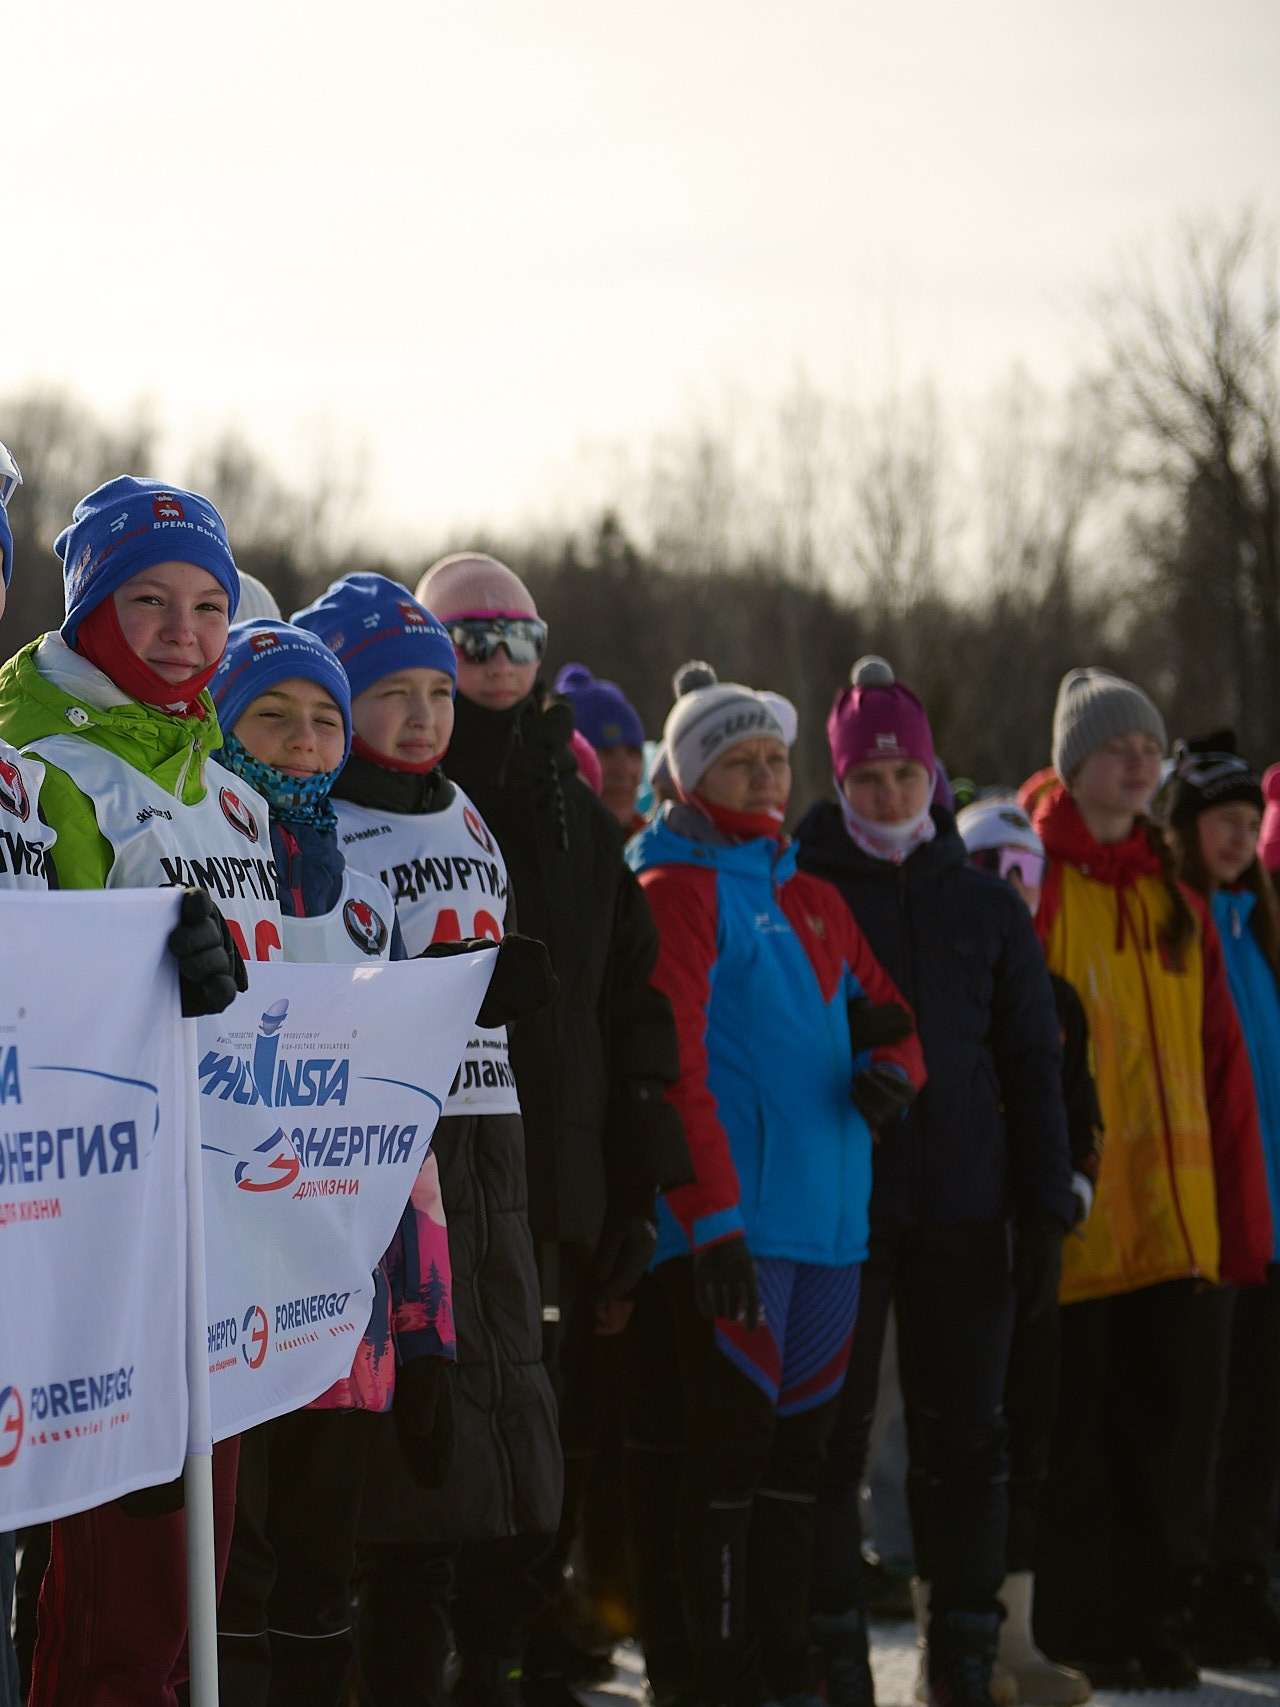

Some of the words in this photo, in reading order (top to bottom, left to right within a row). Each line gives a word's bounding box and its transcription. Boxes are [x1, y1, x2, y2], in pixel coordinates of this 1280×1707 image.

[153, 520, 194, 530] ВРЕМЯ
[196, 525, 224, 546] БЫТЬ
[253, 644, 289, 662] ВРЕМЯ
[292, 643, 322, 657] БЫТЬ
[342, 824, 393, 845] ski-leader.ru
[291, 1124, 419, 1168] ЭНЕРГИЯ
[275, 1291, 351, 1334] FORENERGO
[275, 1330, 320, 1353] industrial
